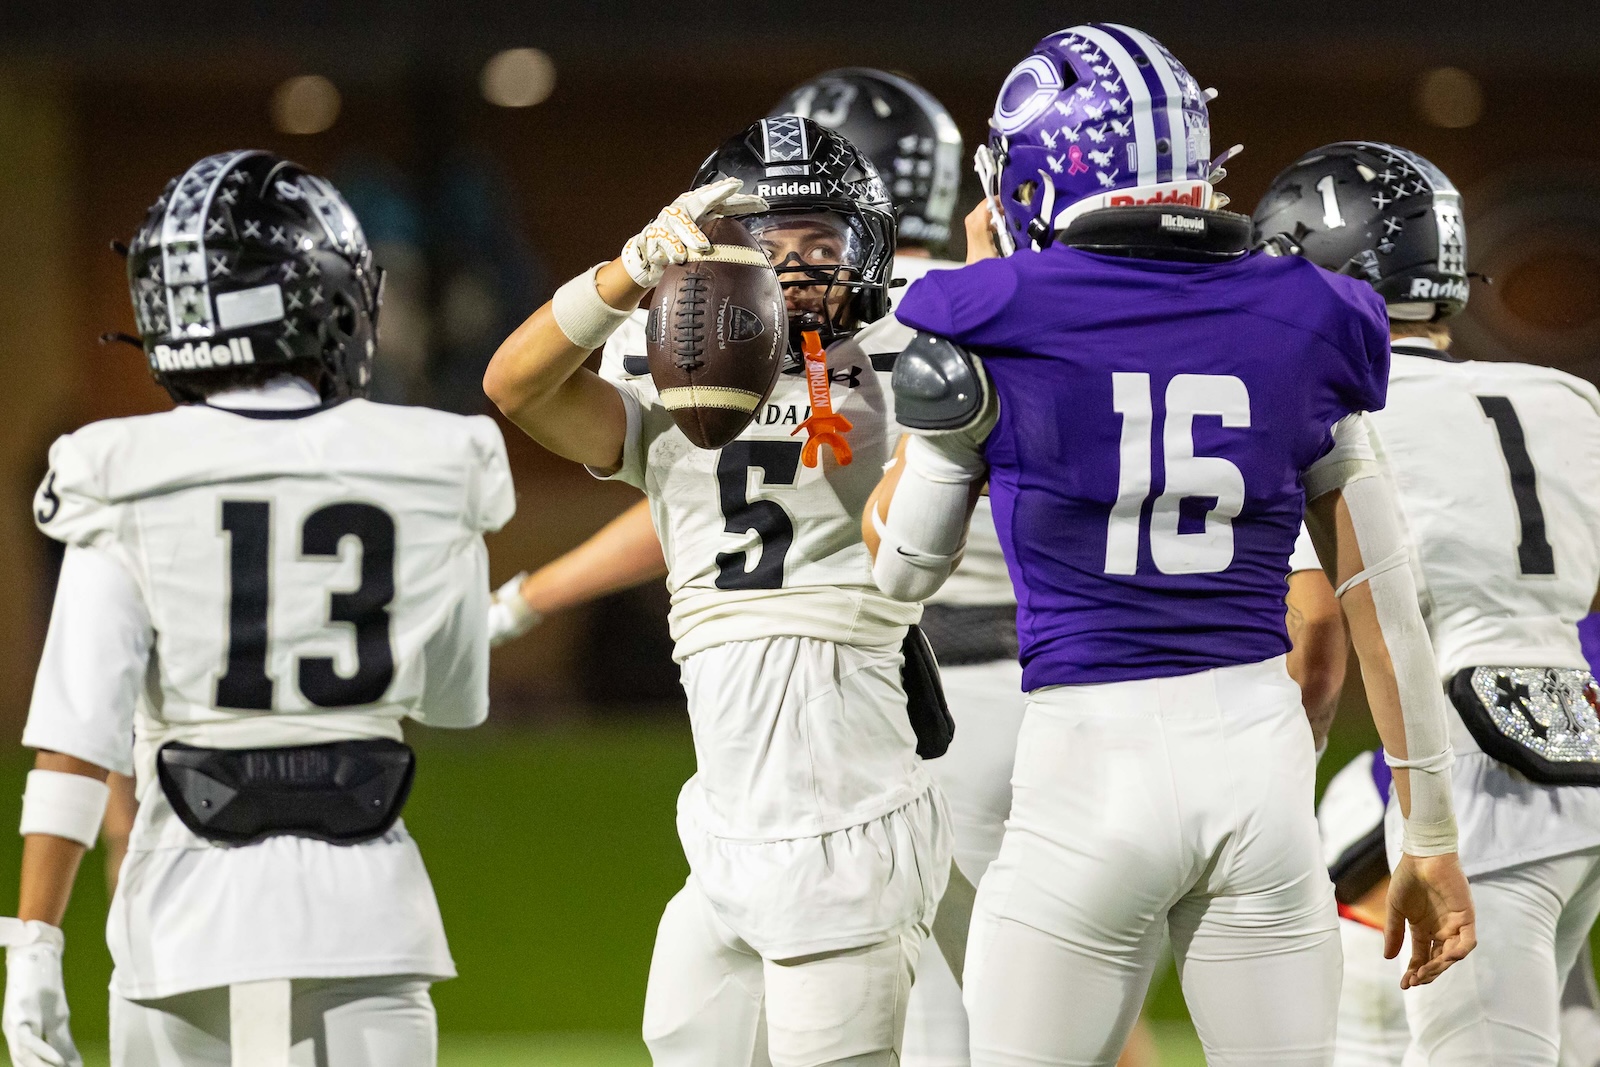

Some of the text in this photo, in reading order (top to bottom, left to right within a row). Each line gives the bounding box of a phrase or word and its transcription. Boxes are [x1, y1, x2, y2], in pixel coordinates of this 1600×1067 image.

[993, 53, 1064, 136] C
[757, 181, 822, 198] Riddell
[1316, 174, 1347, 229] 1
[1161, 213, 1205, 230] McDavid
[716, 295, 731, 350] RANDALL
[733, 309, 742, 340] RAIDERS
[155, 336, 255, 373] Riddell
[1104, 372, 1251, 575] 16
[1475, 395, 1556, 575] 1
[714, 440, 803, 590] 5
[213, 499, 397, 712] 13
